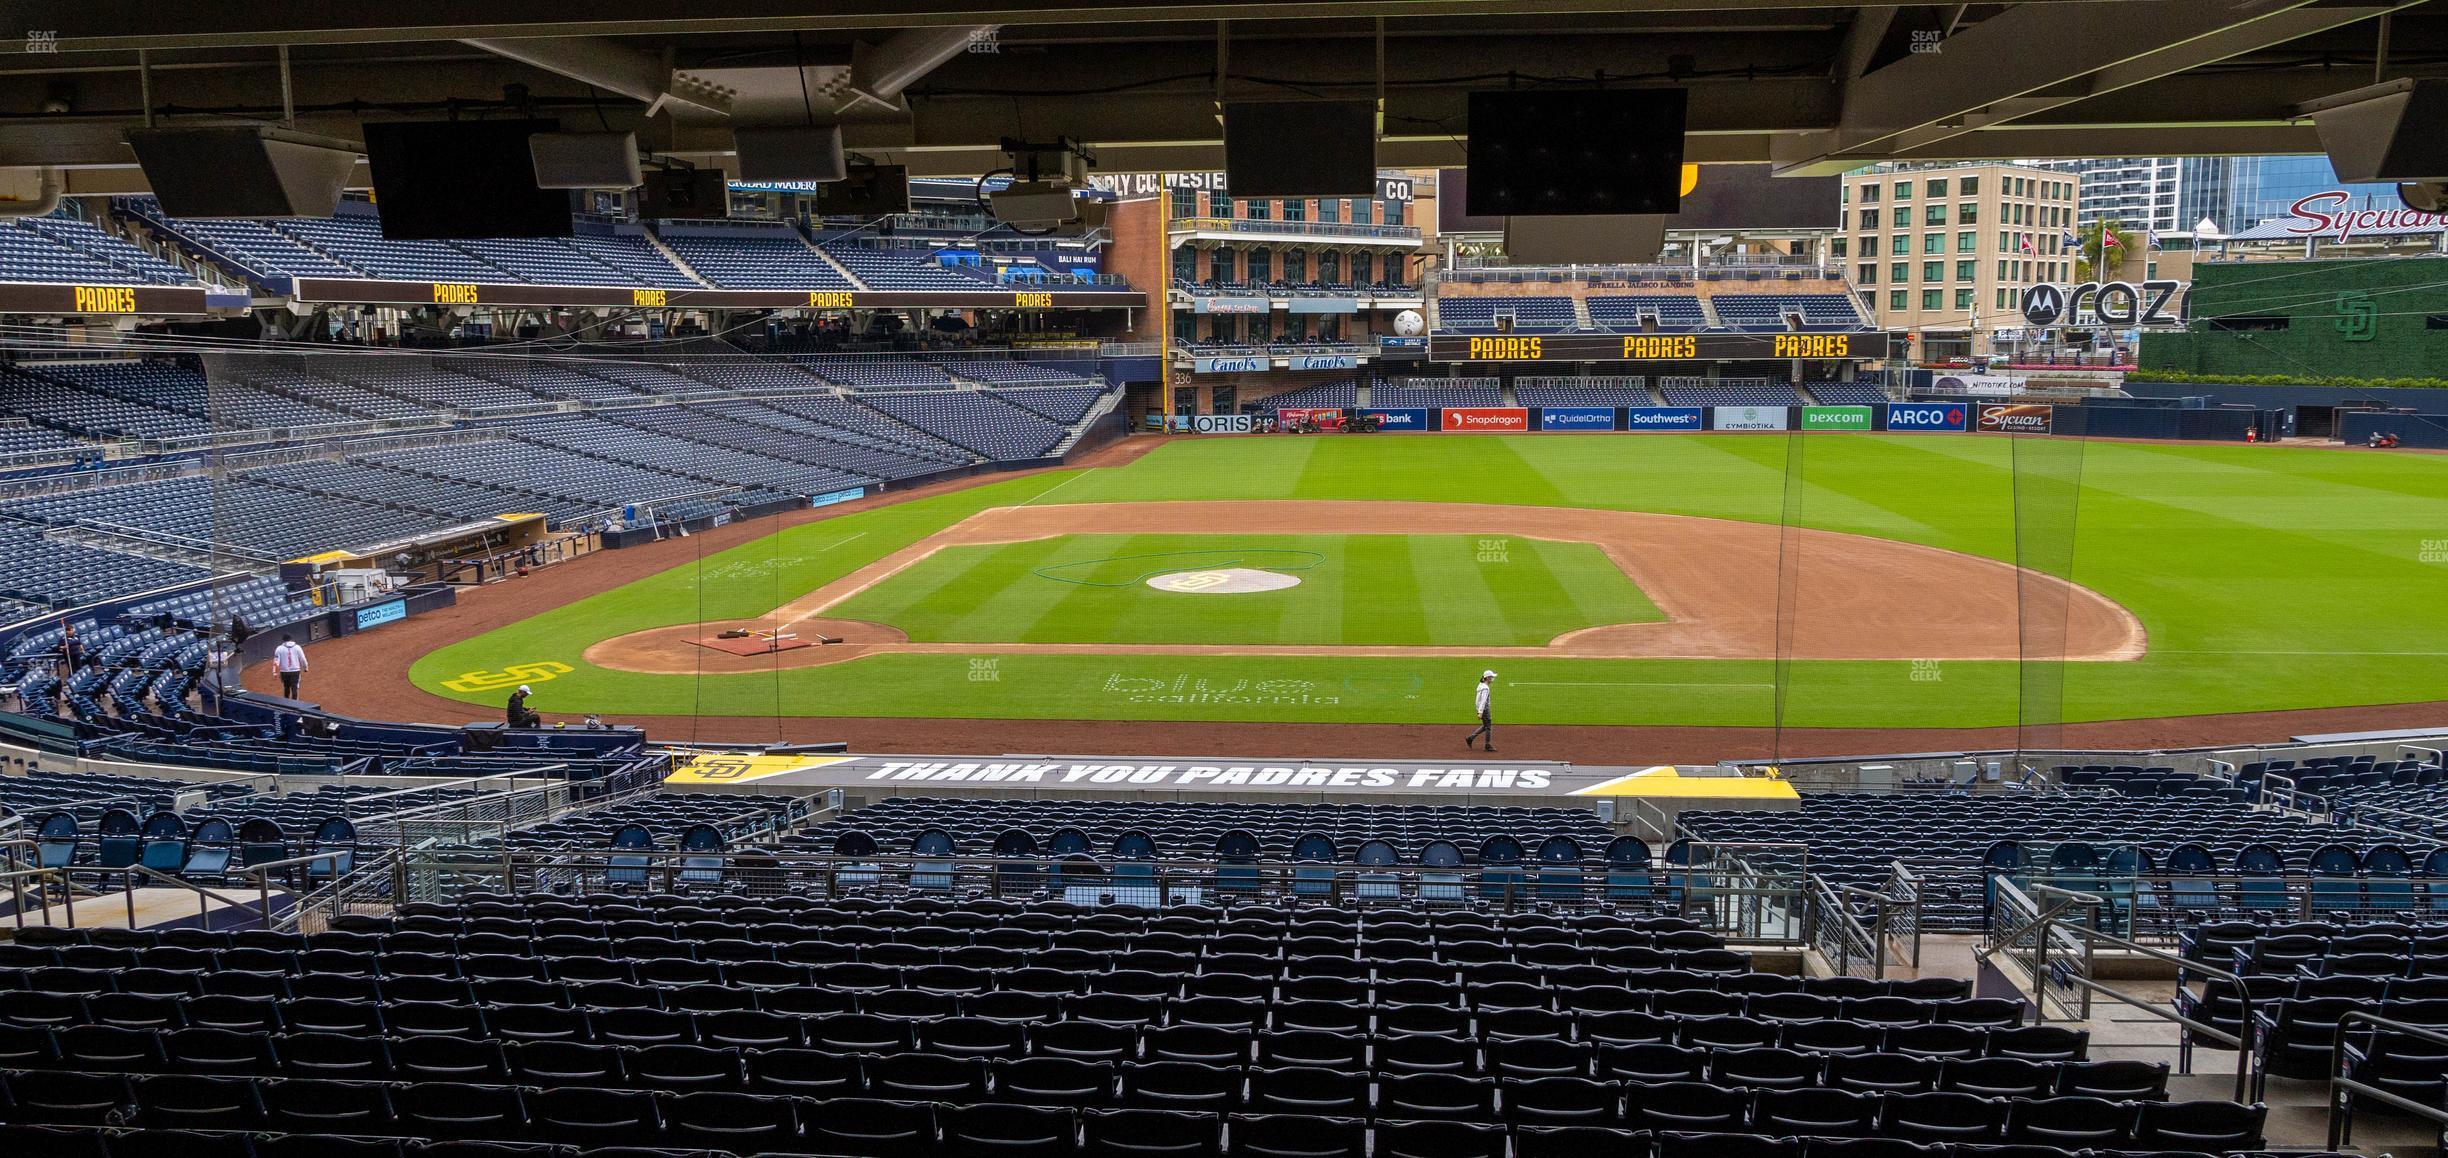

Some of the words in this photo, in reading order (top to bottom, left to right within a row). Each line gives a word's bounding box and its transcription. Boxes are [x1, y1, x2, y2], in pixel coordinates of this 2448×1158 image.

[1164, 172, 1227, 190] WESTE
[1386, 181, 1412, 200] CO.
[2286, 190, 2448, 243] Sycuan
[1058, 255, 1072, 263] BALI
[1072, 255, 1083, 263] HAI
[1083, 255, 1097, 263] RUM
[433, 283, 477, 303] PADRES
[1587, 281, 1626, 289] ESTRELLA
[1627, 281, 1659, 289] JALISCO
[75, 286, 135, 313] PADRES
[633, 289, 666, 307] PADRES
[810, 292, 853, 307] PADRES
[1015, 292, 1052, 307] PADRES
[1470, 337, 1542, 359] PADRES
[1623, 335, 1695, 358] PADRES
[1774, 335, 1848, 357] PADRES
[1210, 357, 1256, 373] Canel's
[1303, 356, 1346, 370] Canel's
[1175, 373, 1192, 385] 336
[1197, 416, 1249, 432] ORIS
[1386, 413, 1412, 423] bank
[1466, 414, 1522, 426] Snapdragon
[1559, 414, 1611, 424] QuidelOrtho
[1633, 413, 1689, 424] Southwest
[1890, 410, 1944, 424] ARCO
[1982, 406, 2044, 430] Sycuan
[358, 610, 381, 624] petco
[865, 761, 1062, 782] THANK
[1060, 765, 1181, 784] YOU
[1174, 766, 1401, 788] PADRES
[1406, 768, 1552, 789] FANS
